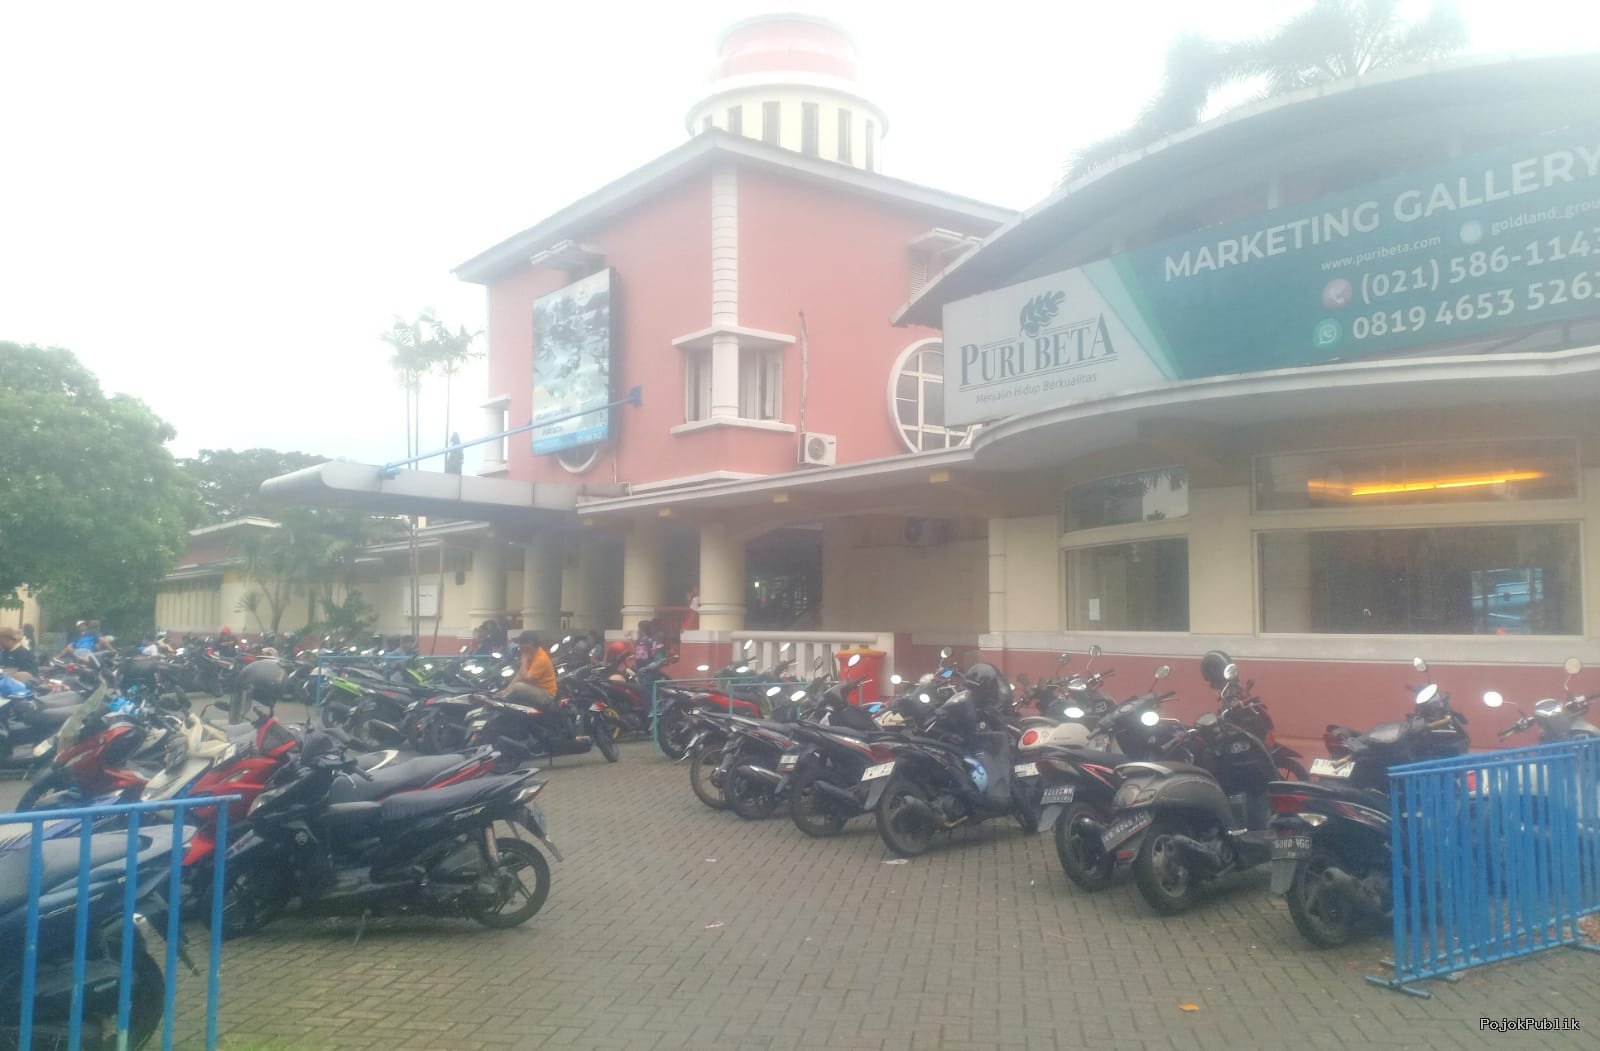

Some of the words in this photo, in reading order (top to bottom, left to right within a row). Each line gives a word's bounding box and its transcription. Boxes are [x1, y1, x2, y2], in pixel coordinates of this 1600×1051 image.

[1164, 201, 1379, 282] MARKETING
[1393, 146, 1600, 223] GALLERY
[1321, 236, 1441, 272] www.puribeta.com
[1361, 258, 1440, 304] (021)
[1352, 305, 1427, 340] 0819
[1435, 287, 1515, 325] 4653
[959, 342, 1026, 387] PURI
[1034, 311, 1119, 371] BETA
[1043, 373, 1097, 392] Berkualitas
